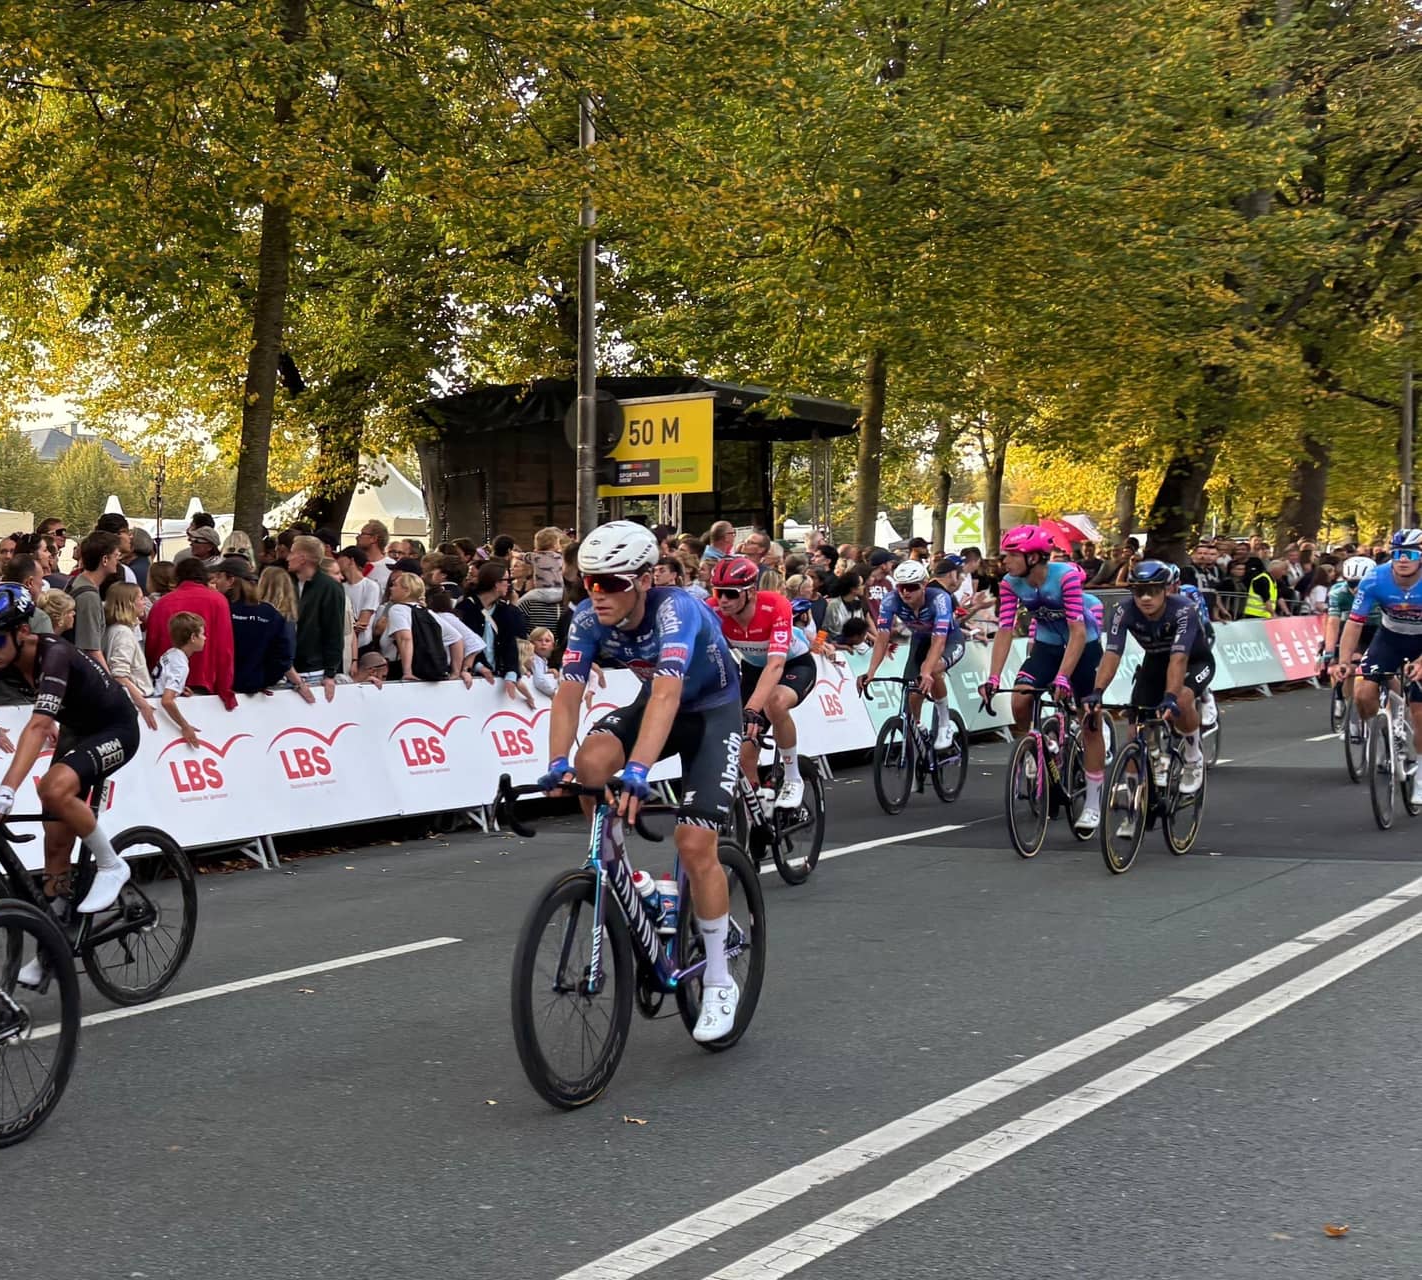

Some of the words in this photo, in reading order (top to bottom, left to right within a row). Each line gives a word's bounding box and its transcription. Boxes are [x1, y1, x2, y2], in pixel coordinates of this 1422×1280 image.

[629, 420, 653, 446] 50
[661, 416, 679, 444] M
[818, 694, 844, 717] LBS
[96, 738, 123, 757] MRW
[399, 735, 446, 767] LBS
[490, 728, 534, 757] LBS
[102, 751, 124, 771] BAU
[169, 757, 224, 793] LBS
[279, 746, 332, 780] LBS
[720, 732, 742, 798] Alpecin
[615, 860, 659, 965] CANYON
